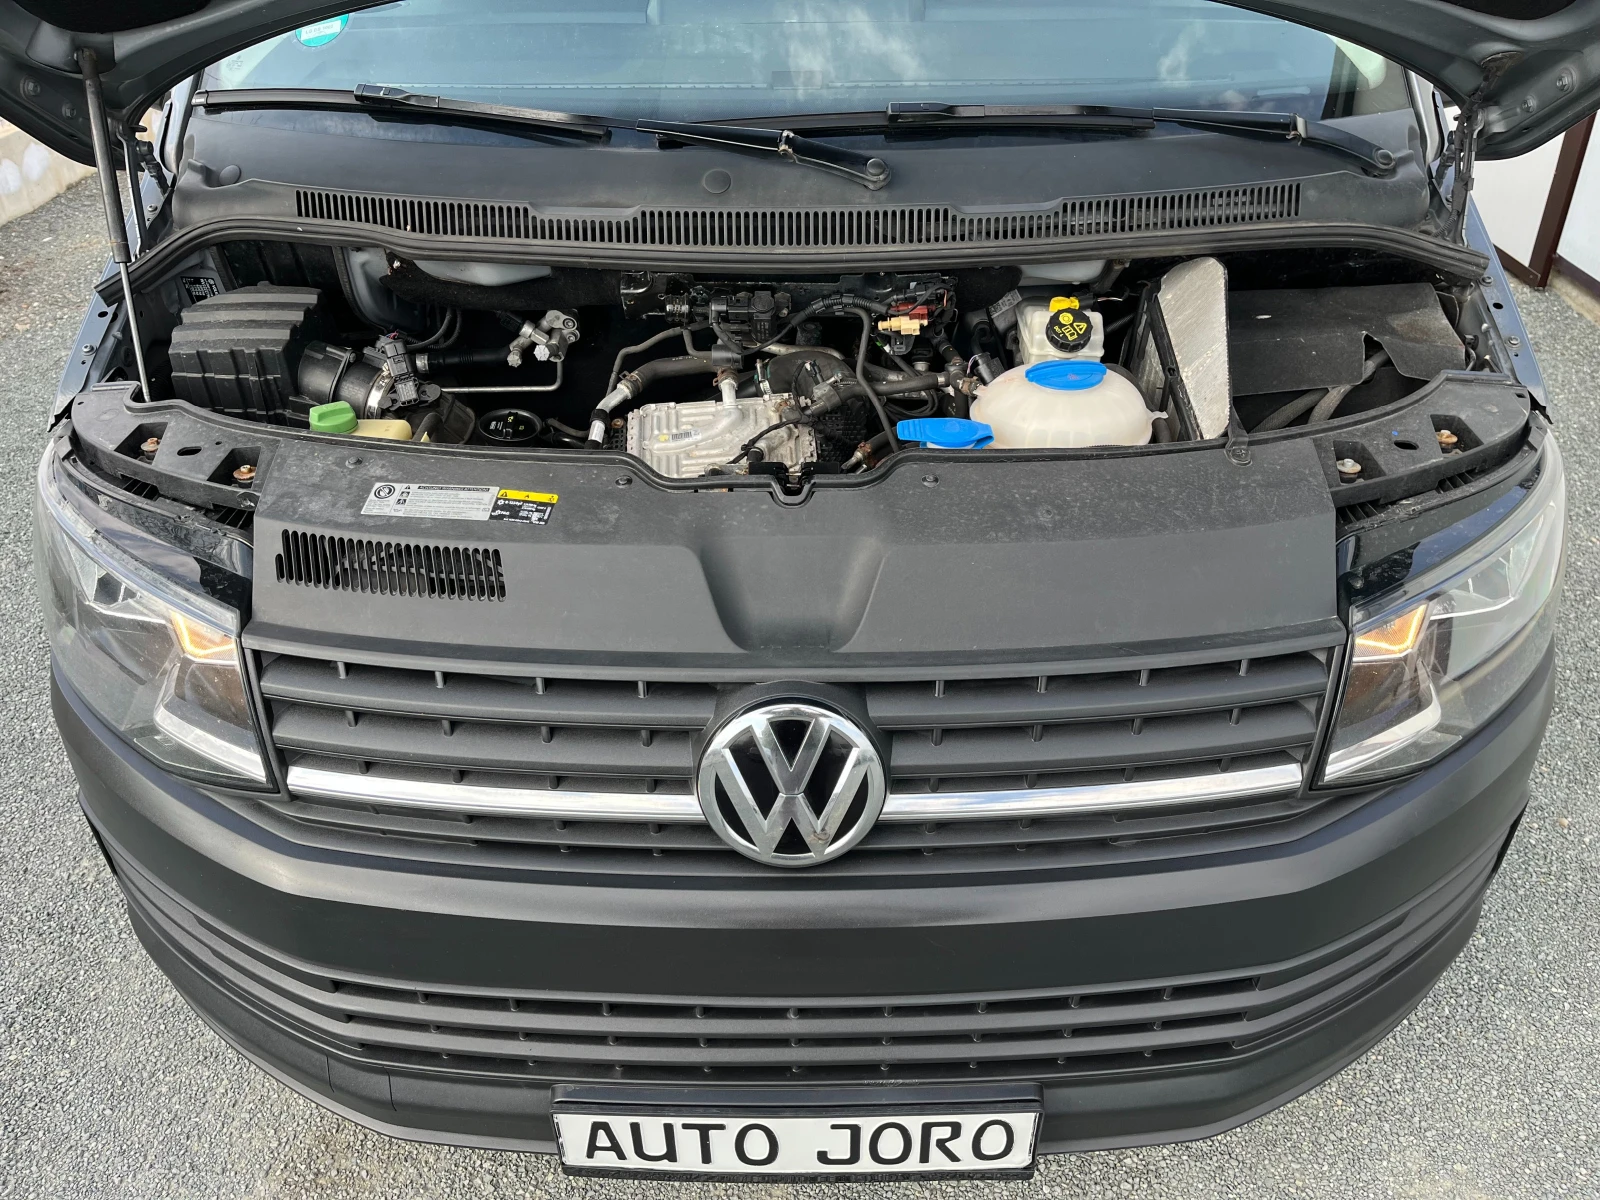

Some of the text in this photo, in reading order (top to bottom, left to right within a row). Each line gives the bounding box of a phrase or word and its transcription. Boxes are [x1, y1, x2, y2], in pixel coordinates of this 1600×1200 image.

[700, 705, 885, 866] VW
[586, 1119, 1016, 1167] AUTO JORO
